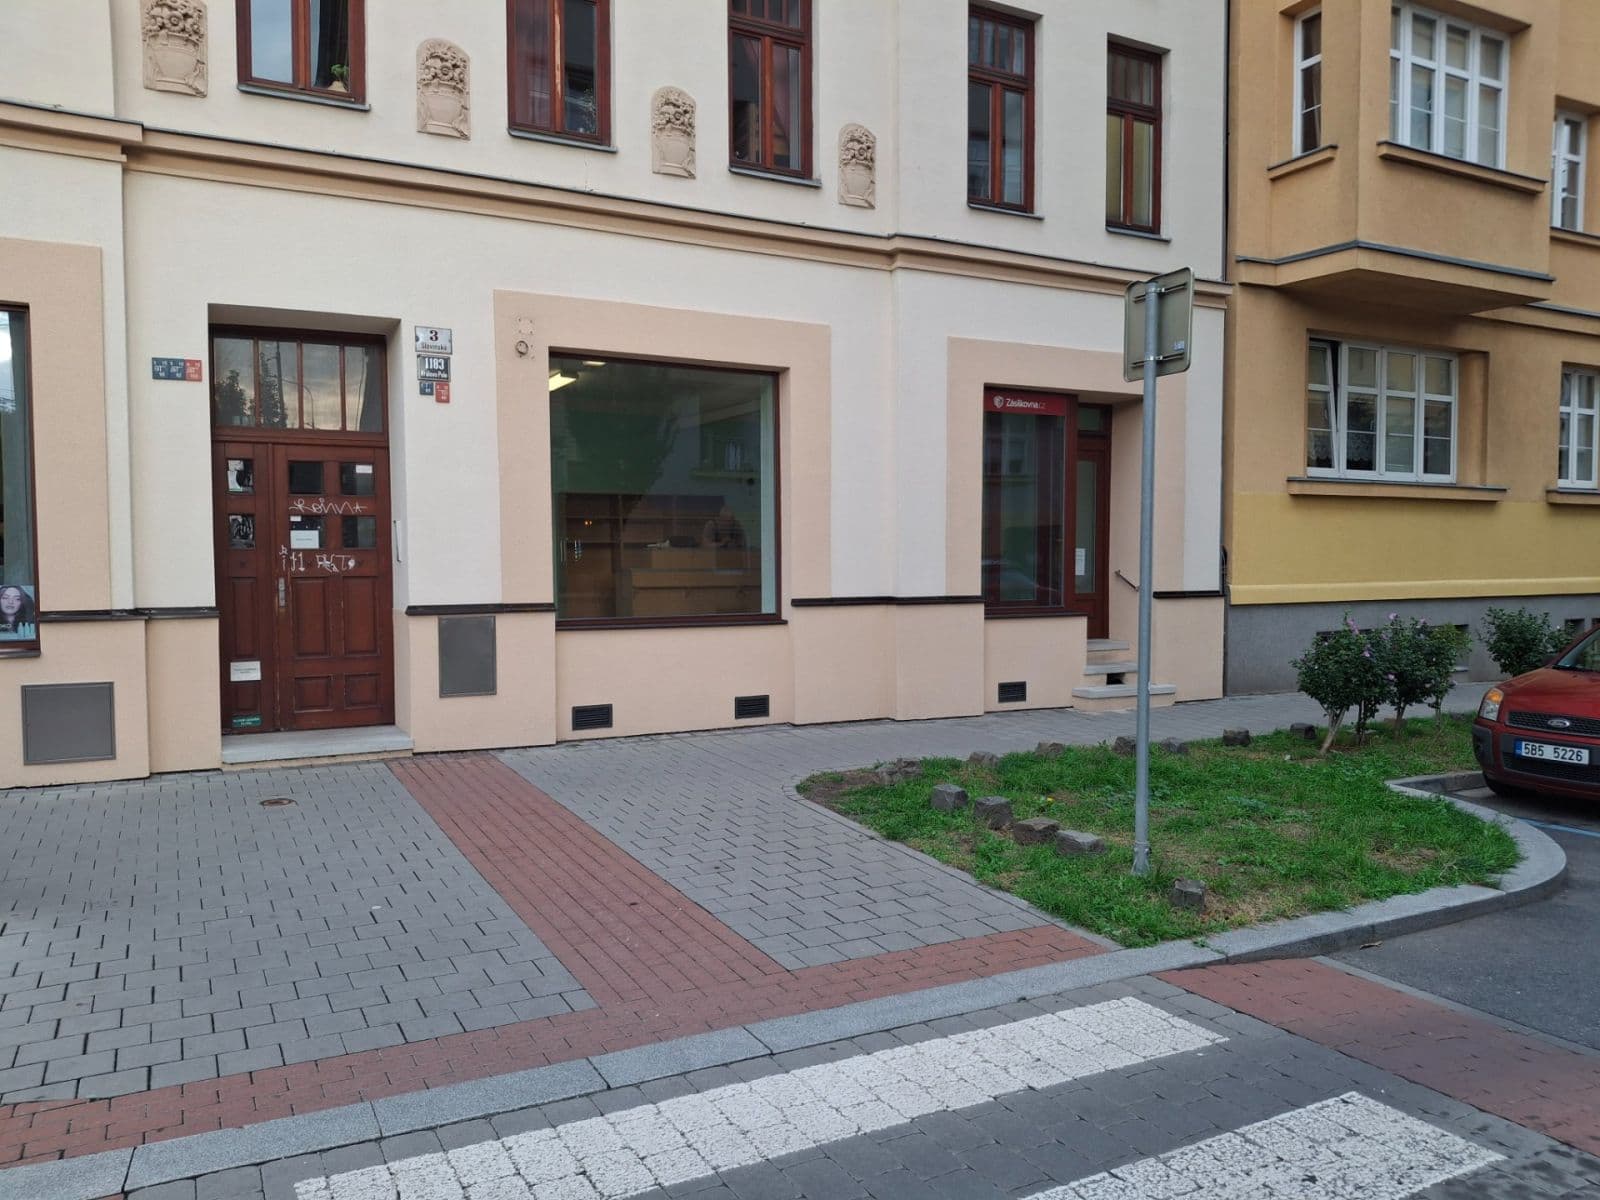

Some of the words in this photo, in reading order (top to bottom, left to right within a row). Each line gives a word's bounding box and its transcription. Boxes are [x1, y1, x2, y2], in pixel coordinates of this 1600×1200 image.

[429, 329, 439, 342] 3
[1524, 743, 1545, 757] 5B5
[1553, 746, 1584, 762] 5226
